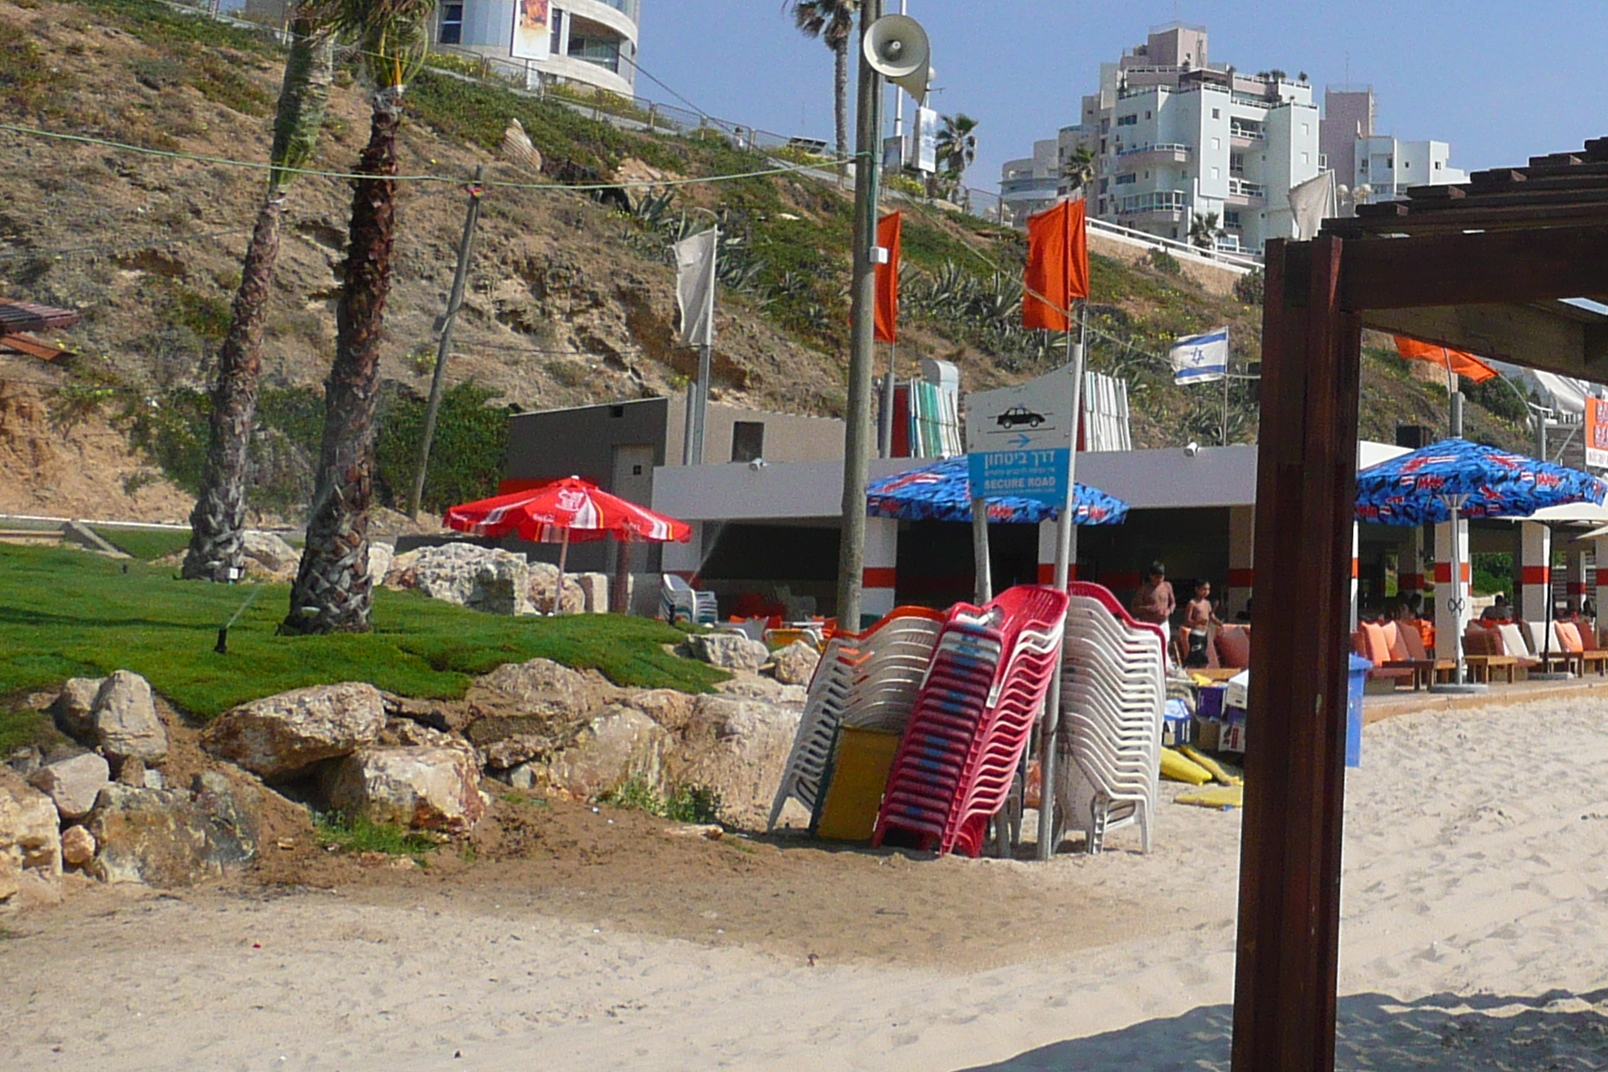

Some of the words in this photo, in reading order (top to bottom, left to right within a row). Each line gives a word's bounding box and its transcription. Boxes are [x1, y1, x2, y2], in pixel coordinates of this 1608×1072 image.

[984, 452, 1027, 469] ביטחון
[1031, 450, 1055, 467] דרך
[984, 477, 1025, 489] SECURE
[1028, 476, 1056, 487] ROAD
